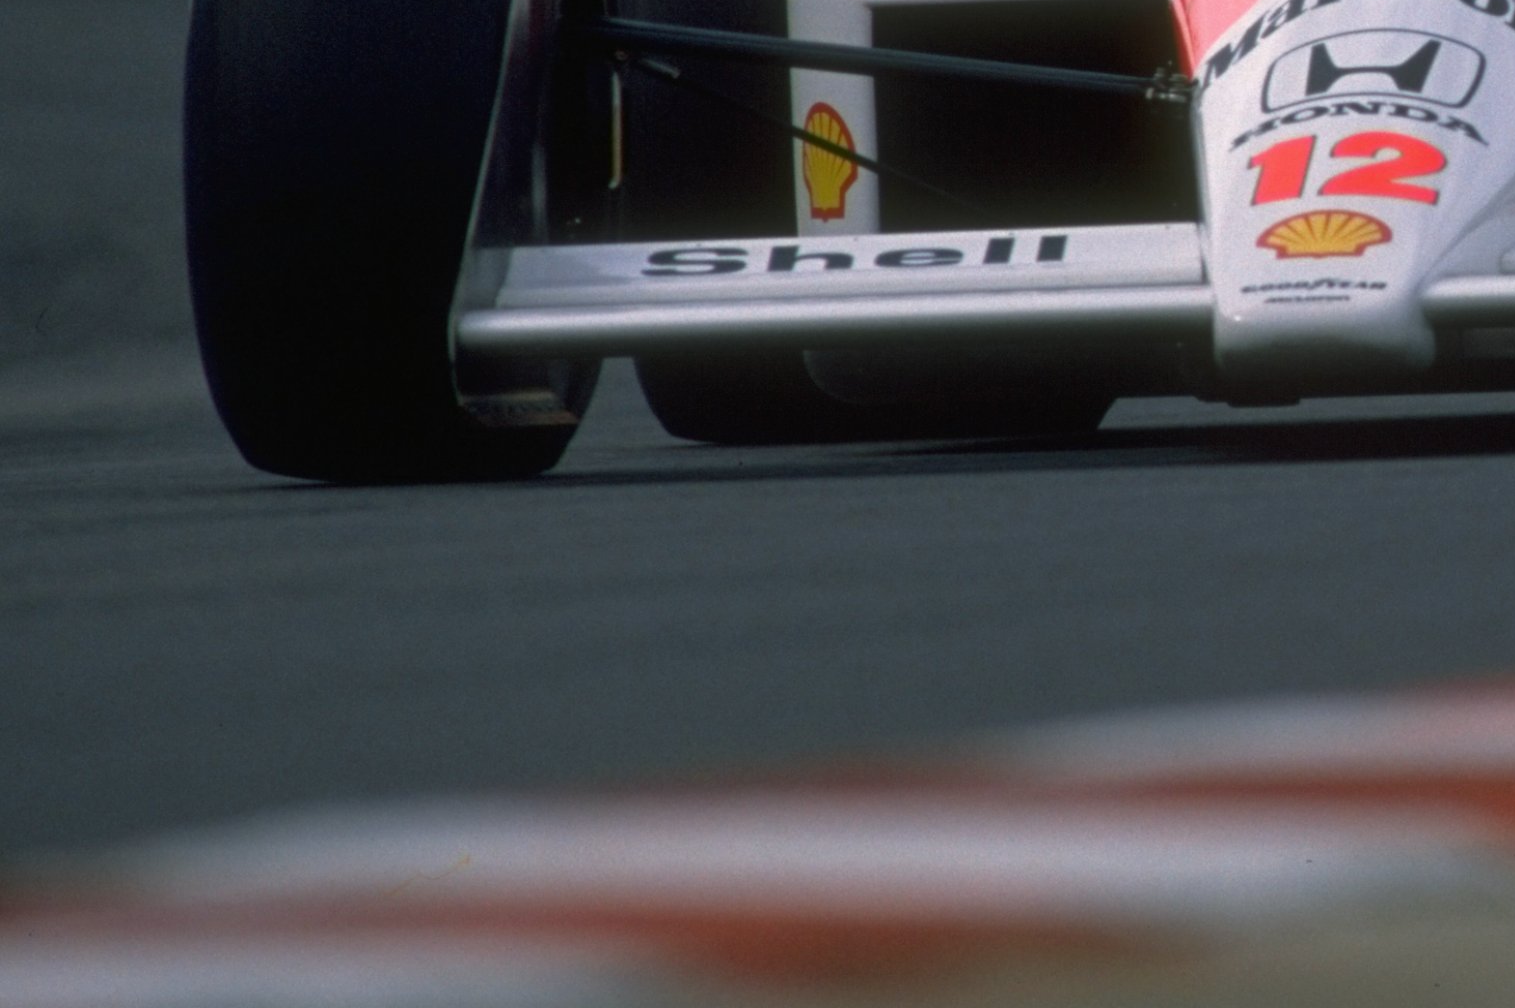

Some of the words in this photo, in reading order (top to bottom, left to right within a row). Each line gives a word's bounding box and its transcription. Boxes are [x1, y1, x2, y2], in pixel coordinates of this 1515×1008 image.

[1228, 101, 1489, 152] HONDA
[1246, 130, 1448, 207] 12
[640, 234, 1068, 277] Shell
